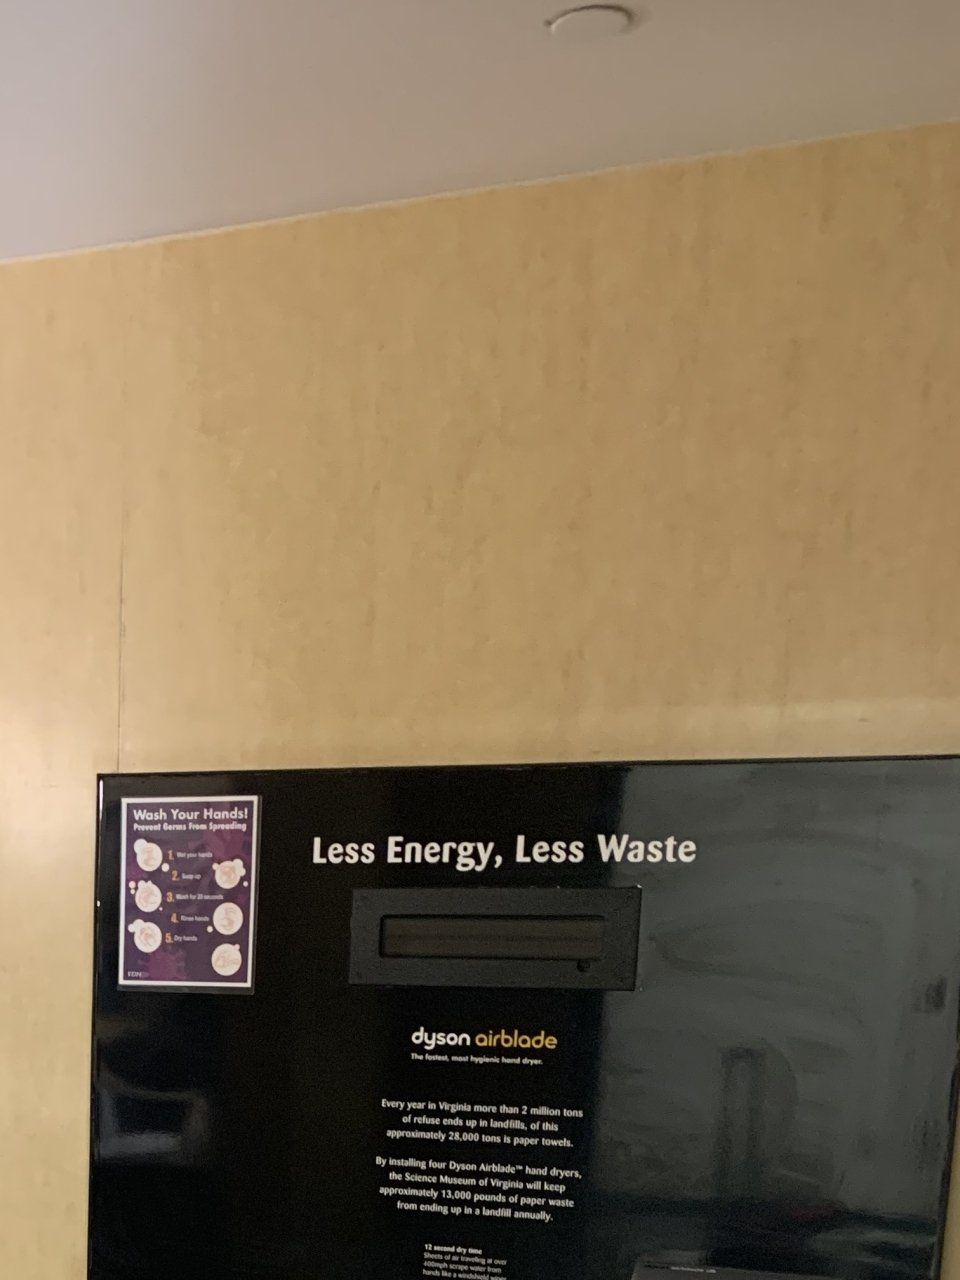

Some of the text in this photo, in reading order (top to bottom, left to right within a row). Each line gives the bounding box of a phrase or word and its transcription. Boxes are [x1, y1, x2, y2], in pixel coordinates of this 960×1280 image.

[133, 807, 248, 821] Wash Your Hands!
[133, 822, 247, 832] Prevent Germs From Spreading
[312, 834, 697, 872] Less Energy, Less Waste
[411, 1026, 558, 1050] dyson airblade
[425, 1053, 450, 1062] fastest,
[470, 1055, 500, 1064] hygienic
[501, 1056, 521, 1064] hand
[522, 1057, 543, 1066] dryer.
[381, 1098, 584, 1118] Every year in Virginia more than 2 million tons
[402, 1114, 559, 1132] of refuse ends up in landfills, of this
[386, 1129, 574, 1147] approximately 28,000 tons is paper towels.
[375, 1156, 387, 1167] By
[389, 1157, 427, 1170] installing
[428, 1159, 447, 1169] four
[449, 1160, 477, 1172] Dyson
[525, 1165, 548, 1176] hand
[549, 1167, 582, 1179] dryers,
[389, 1171, 566, 1194] the Science Museum of Virginia will keep
[379, 1187, 574, 1208] approximately 13,000 pounds of paper waste
[397, 1200, 553, 1223] from ending up in a landfill annually.
[456, 1246, 467, 1255] dry
